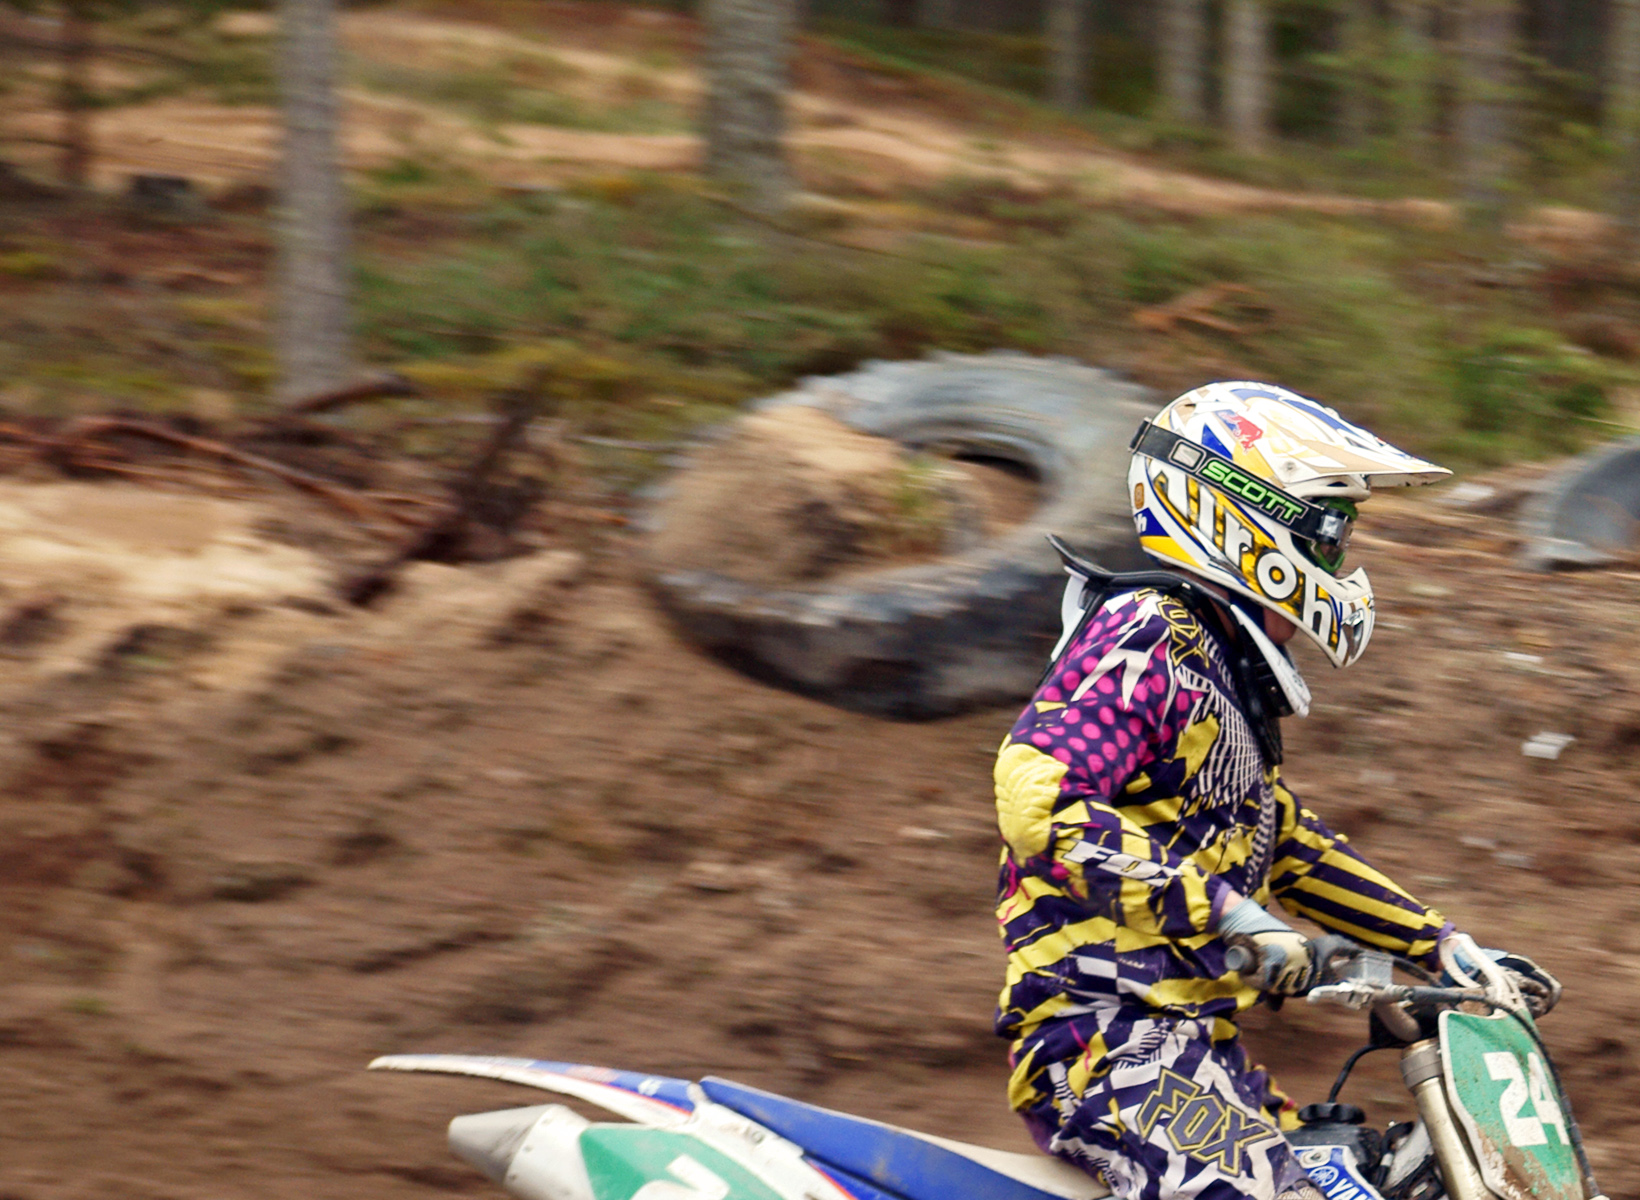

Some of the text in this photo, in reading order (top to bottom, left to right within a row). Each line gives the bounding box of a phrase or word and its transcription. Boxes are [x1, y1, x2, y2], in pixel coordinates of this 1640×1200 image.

[1202, 459, 1303, 521] SCOTT
[1135, 1065, 1277, 1177] FOX
[1483, 1051, 1571, 1147] 24
